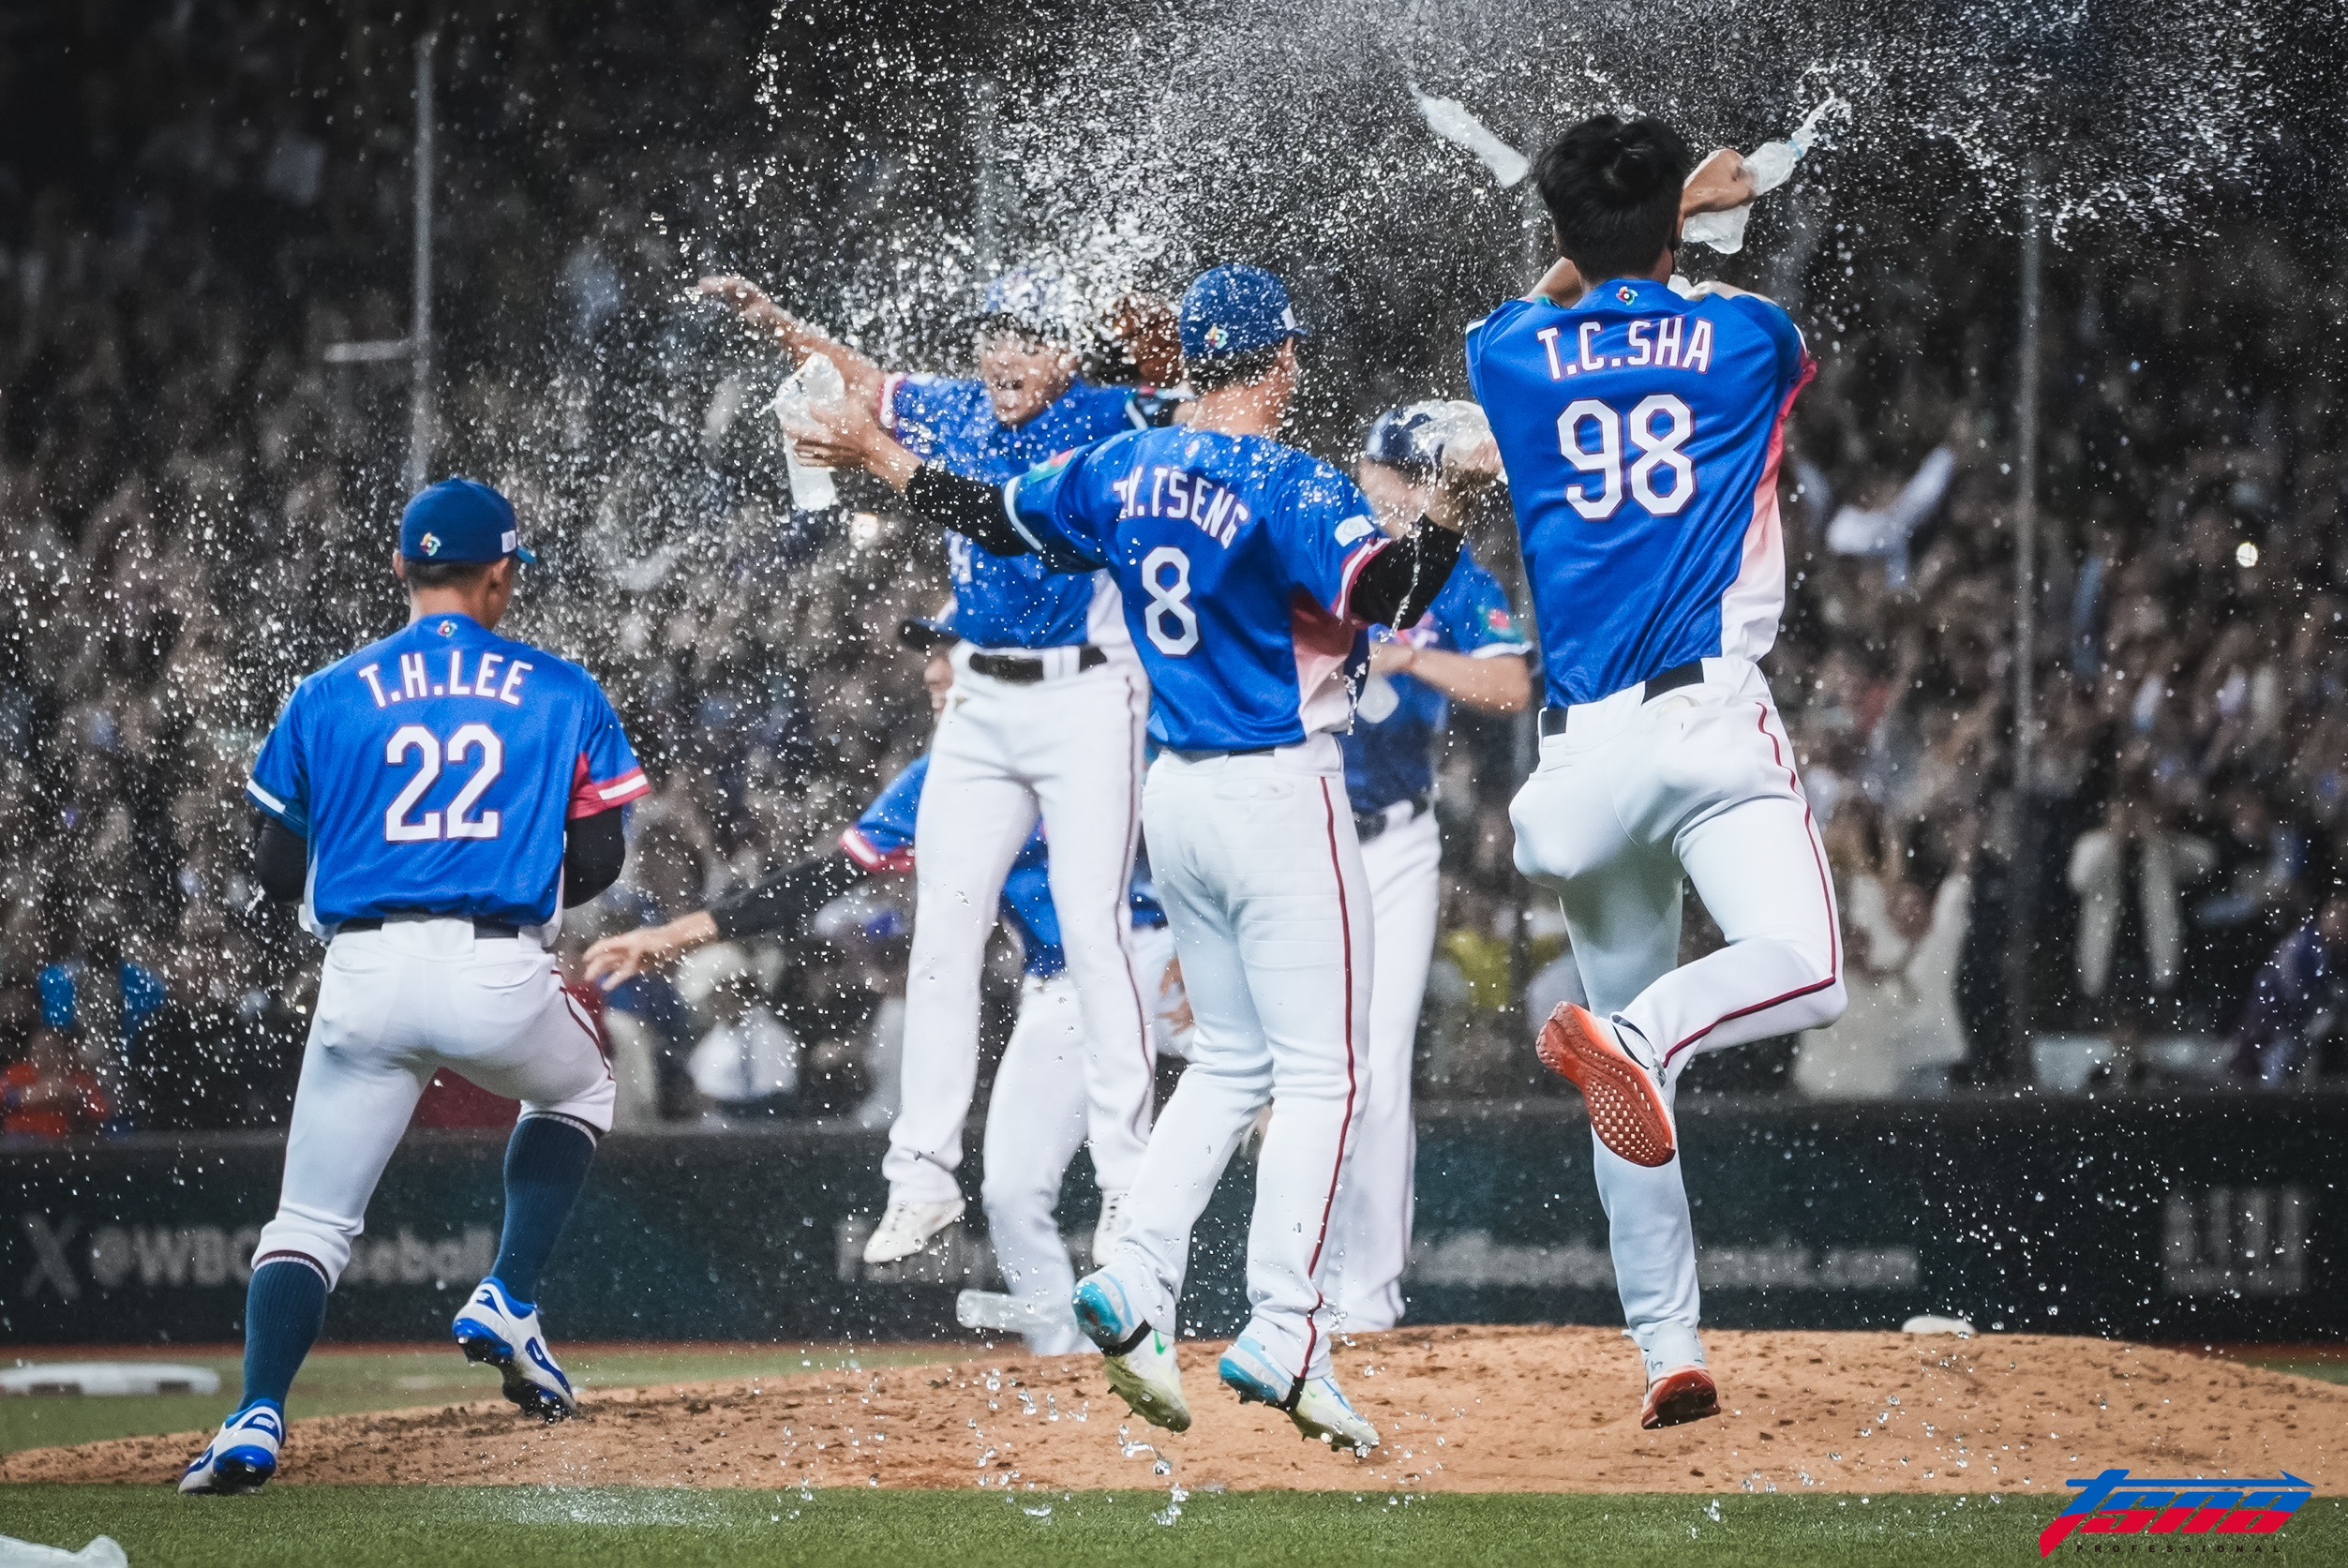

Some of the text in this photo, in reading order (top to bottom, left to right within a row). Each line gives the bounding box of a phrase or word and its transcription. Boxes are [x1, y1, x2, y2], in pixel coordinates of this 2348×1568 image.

[1537, 317, 1713, 381] T.C.SHA
[1555, 392, 1697, 521] 98
[1141, 545, 1201, 657] 8
[358, 650, 534, 709] T.H.LEE
[384, 723, 503, 843] 22
